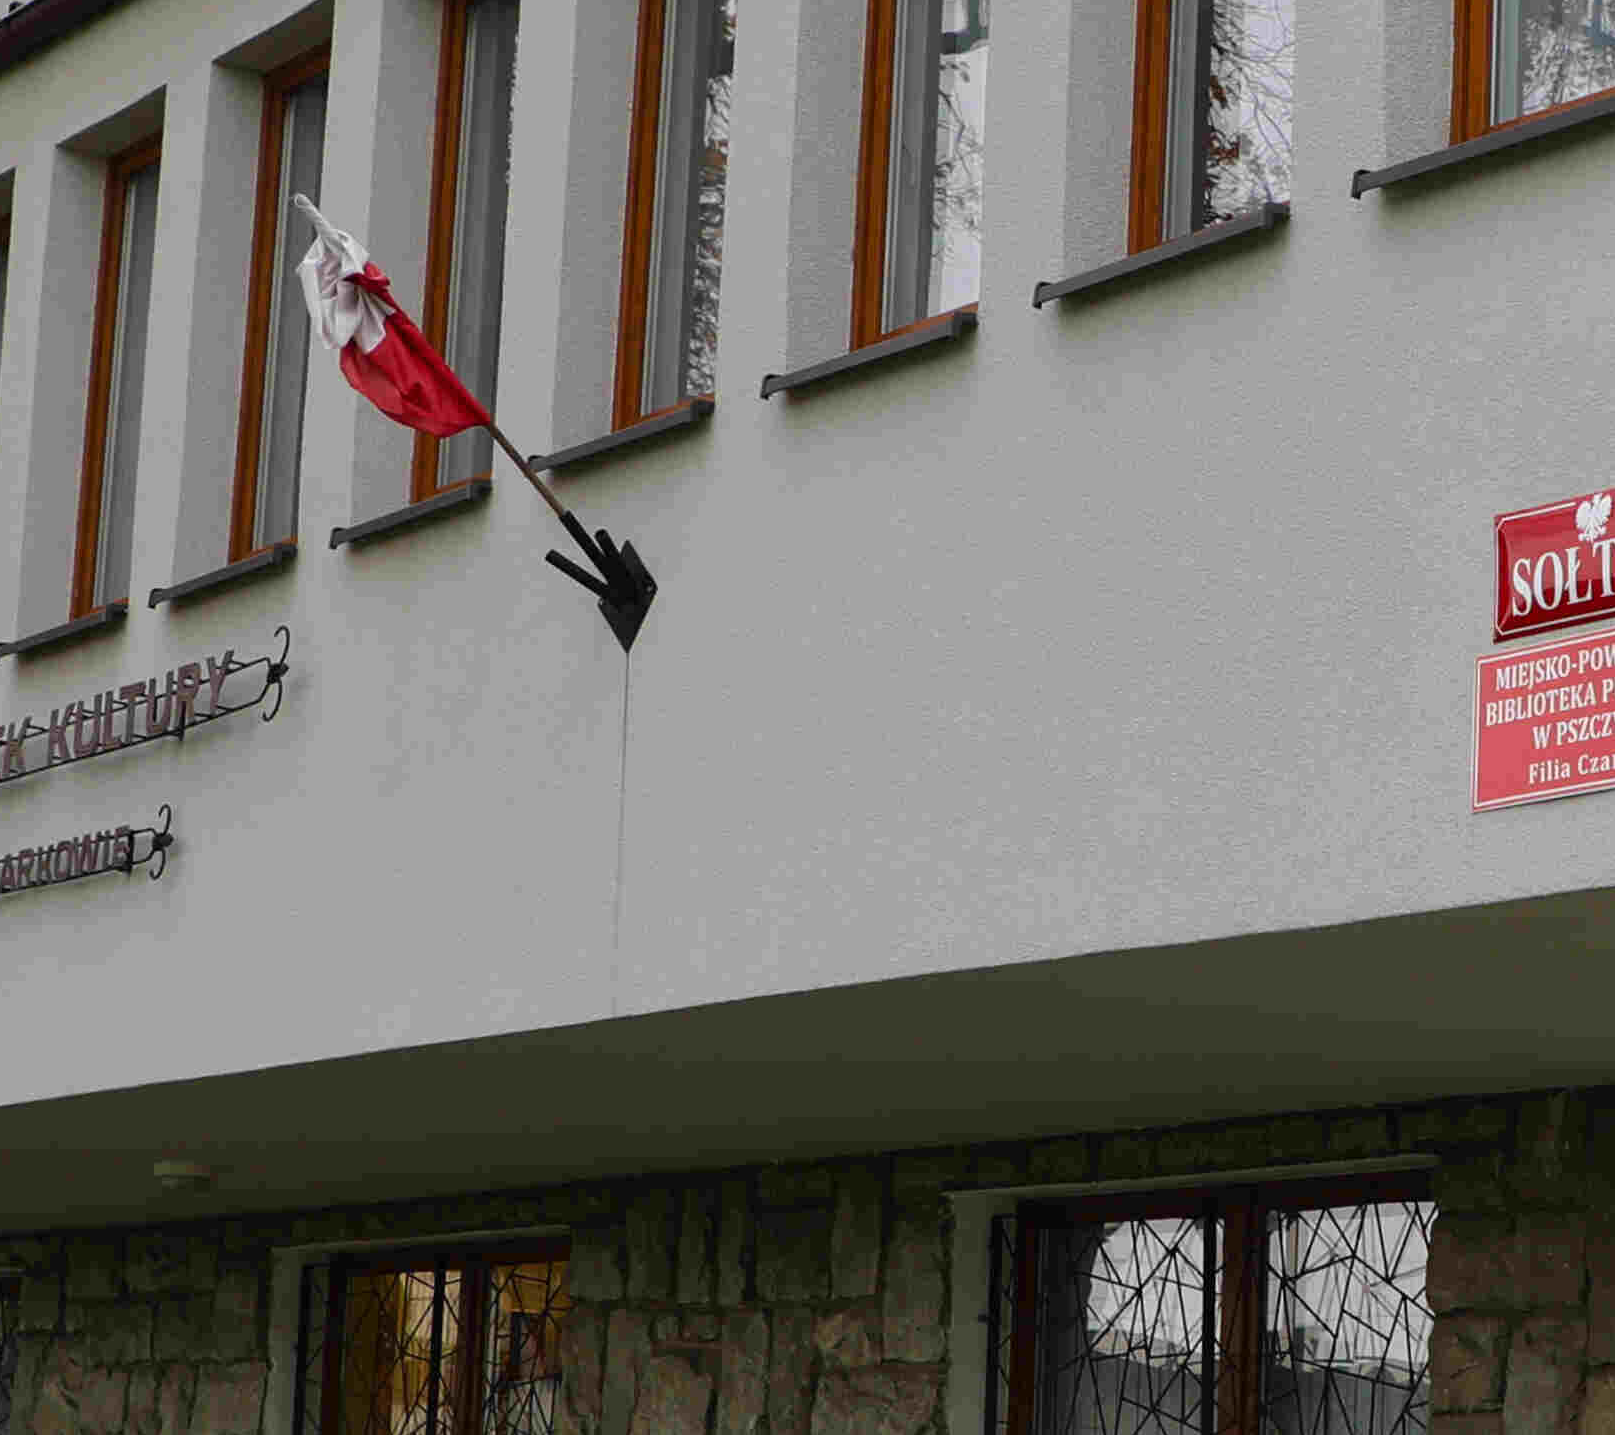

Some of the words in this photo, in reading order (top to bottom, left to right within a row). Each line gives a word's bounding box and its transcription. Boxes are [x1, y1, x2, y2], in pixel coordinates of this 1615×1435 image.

[47, 649, 235, 767] KULTURY
[1485, 683, 1597, 726] BIBLIOTEKA
[1532, 723, 1552, 750] W
[1528, 757, 1572, 785] Filia
